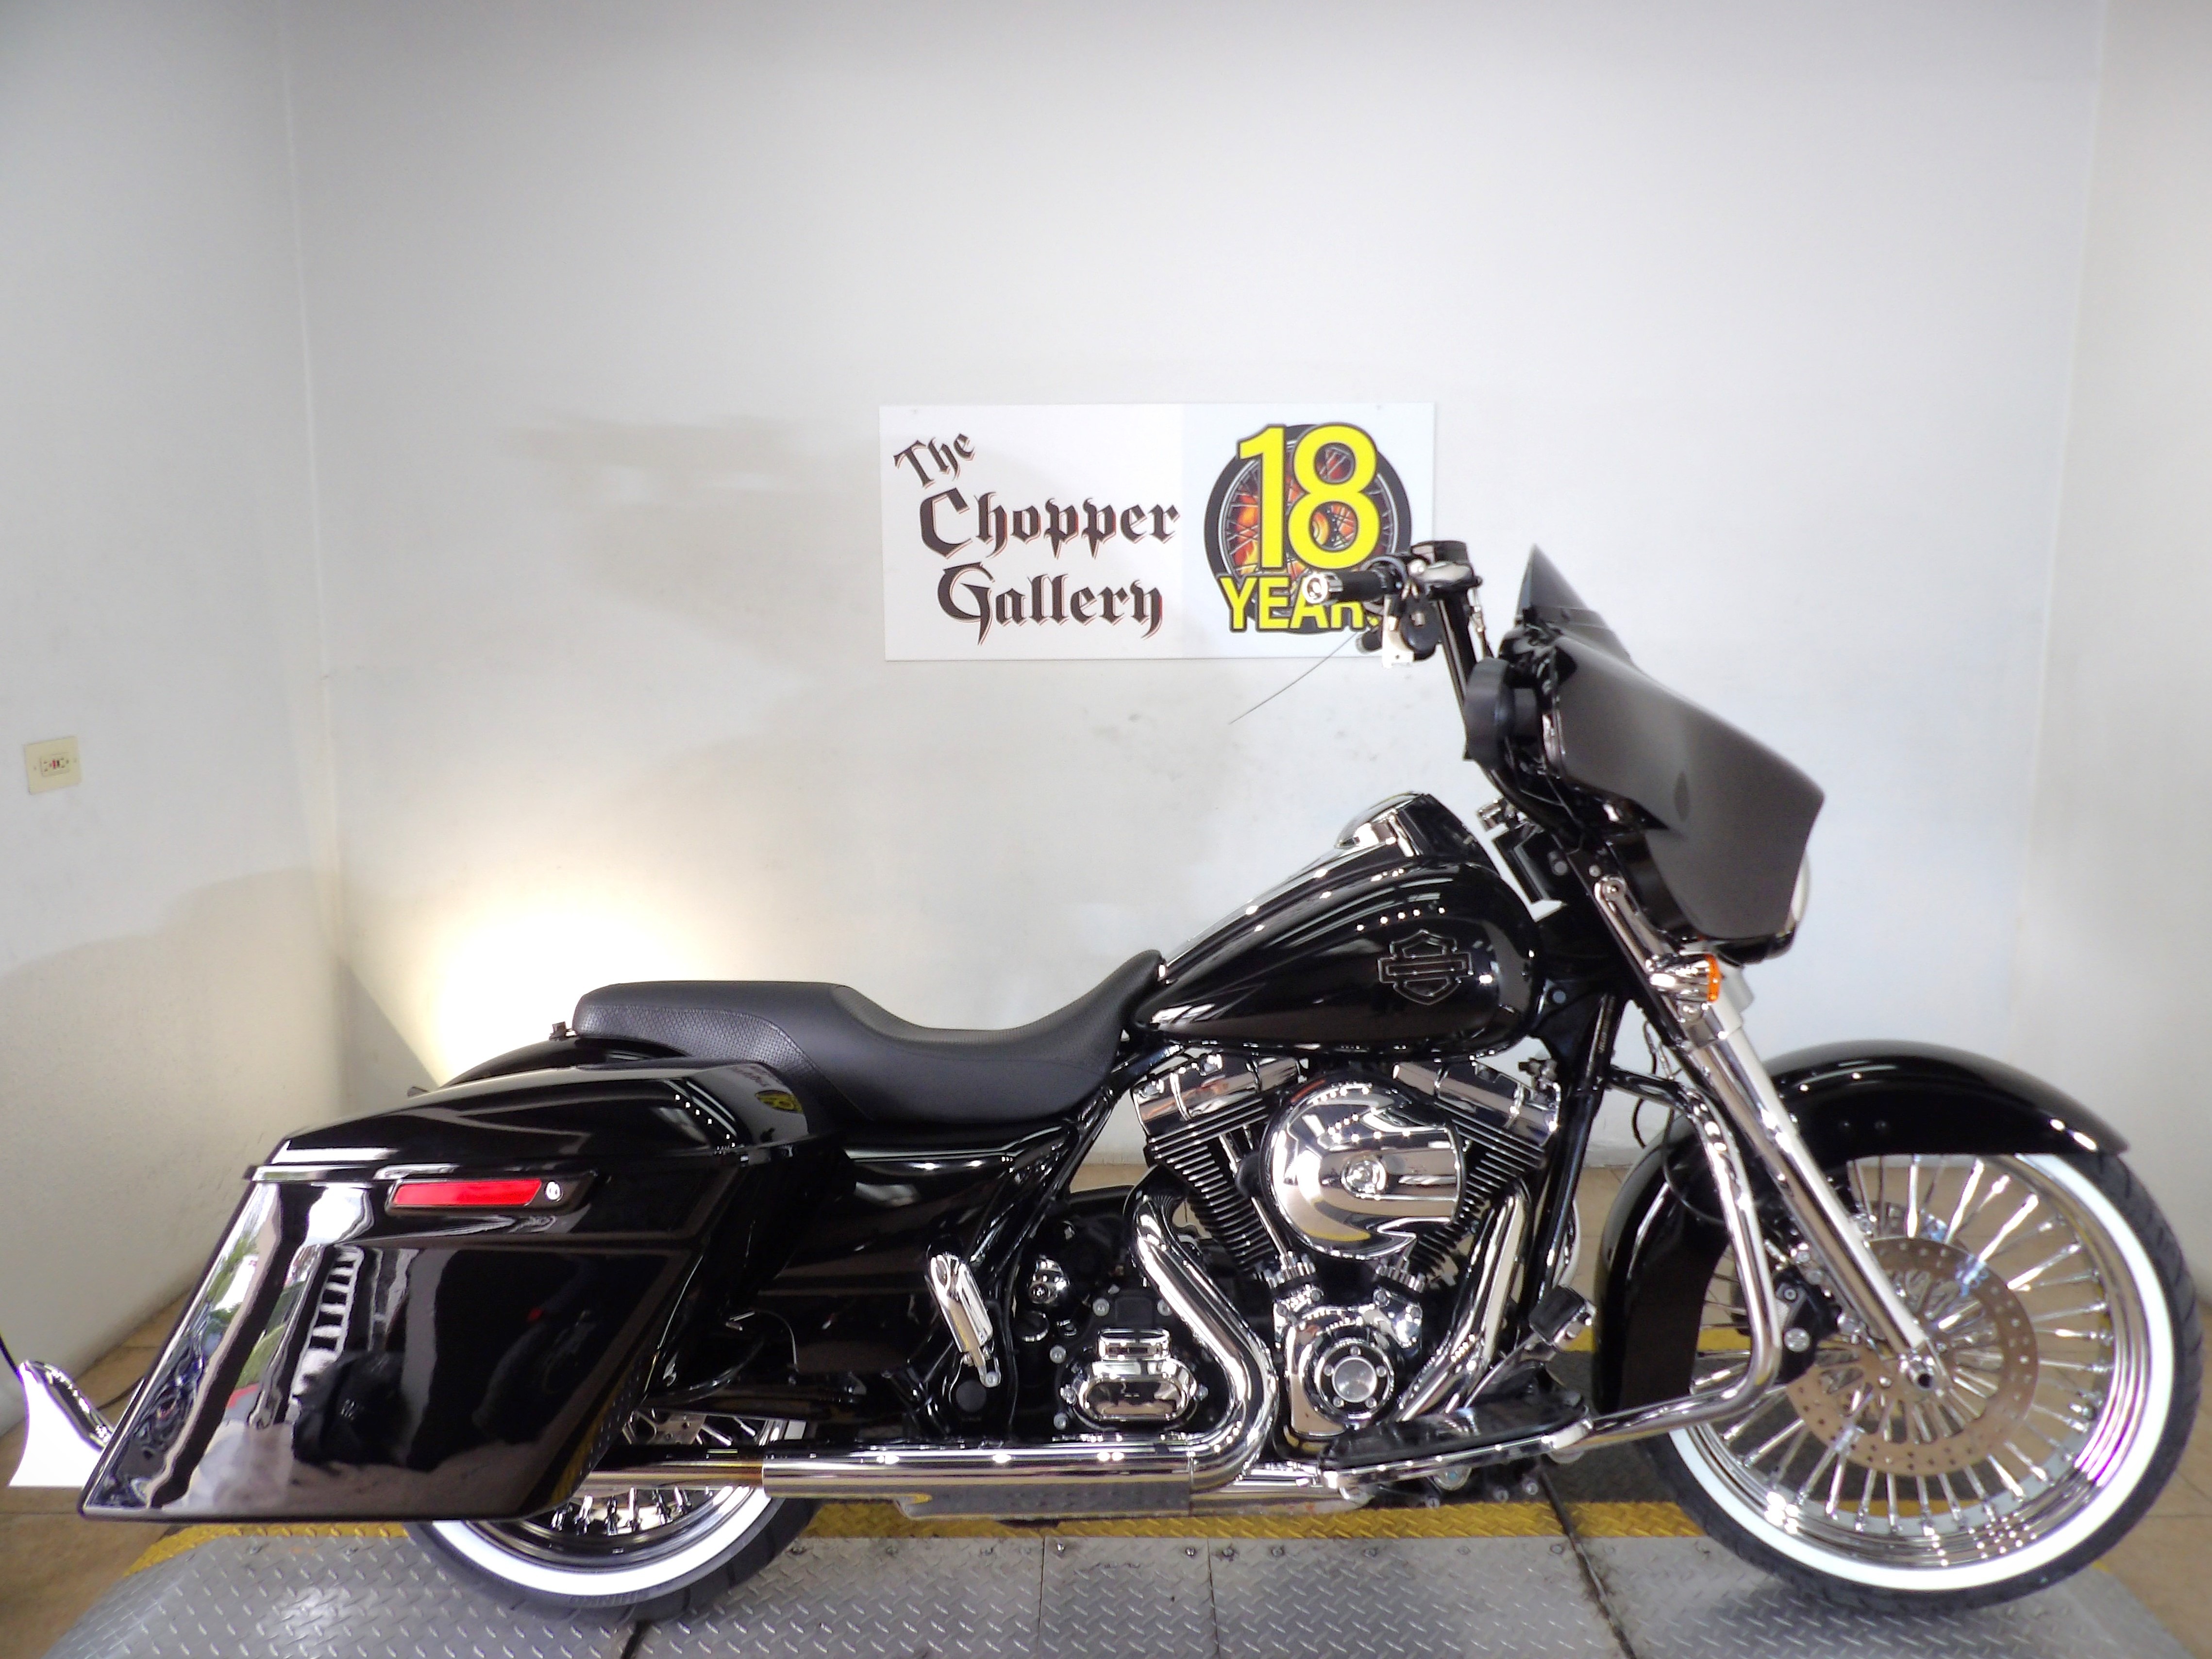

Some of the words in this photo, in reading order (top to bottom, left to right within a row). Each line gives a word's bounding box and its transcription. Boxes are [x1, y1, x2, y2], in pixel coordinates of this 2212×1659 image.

[893, 433, 975, 488] The
[920, 487, 1180, 559] Chopper
[1237, 423, 1382, 571] 18
[937, 562, 1163, 646] Gallery
[1218, 575, 1380, 629] YEAR
